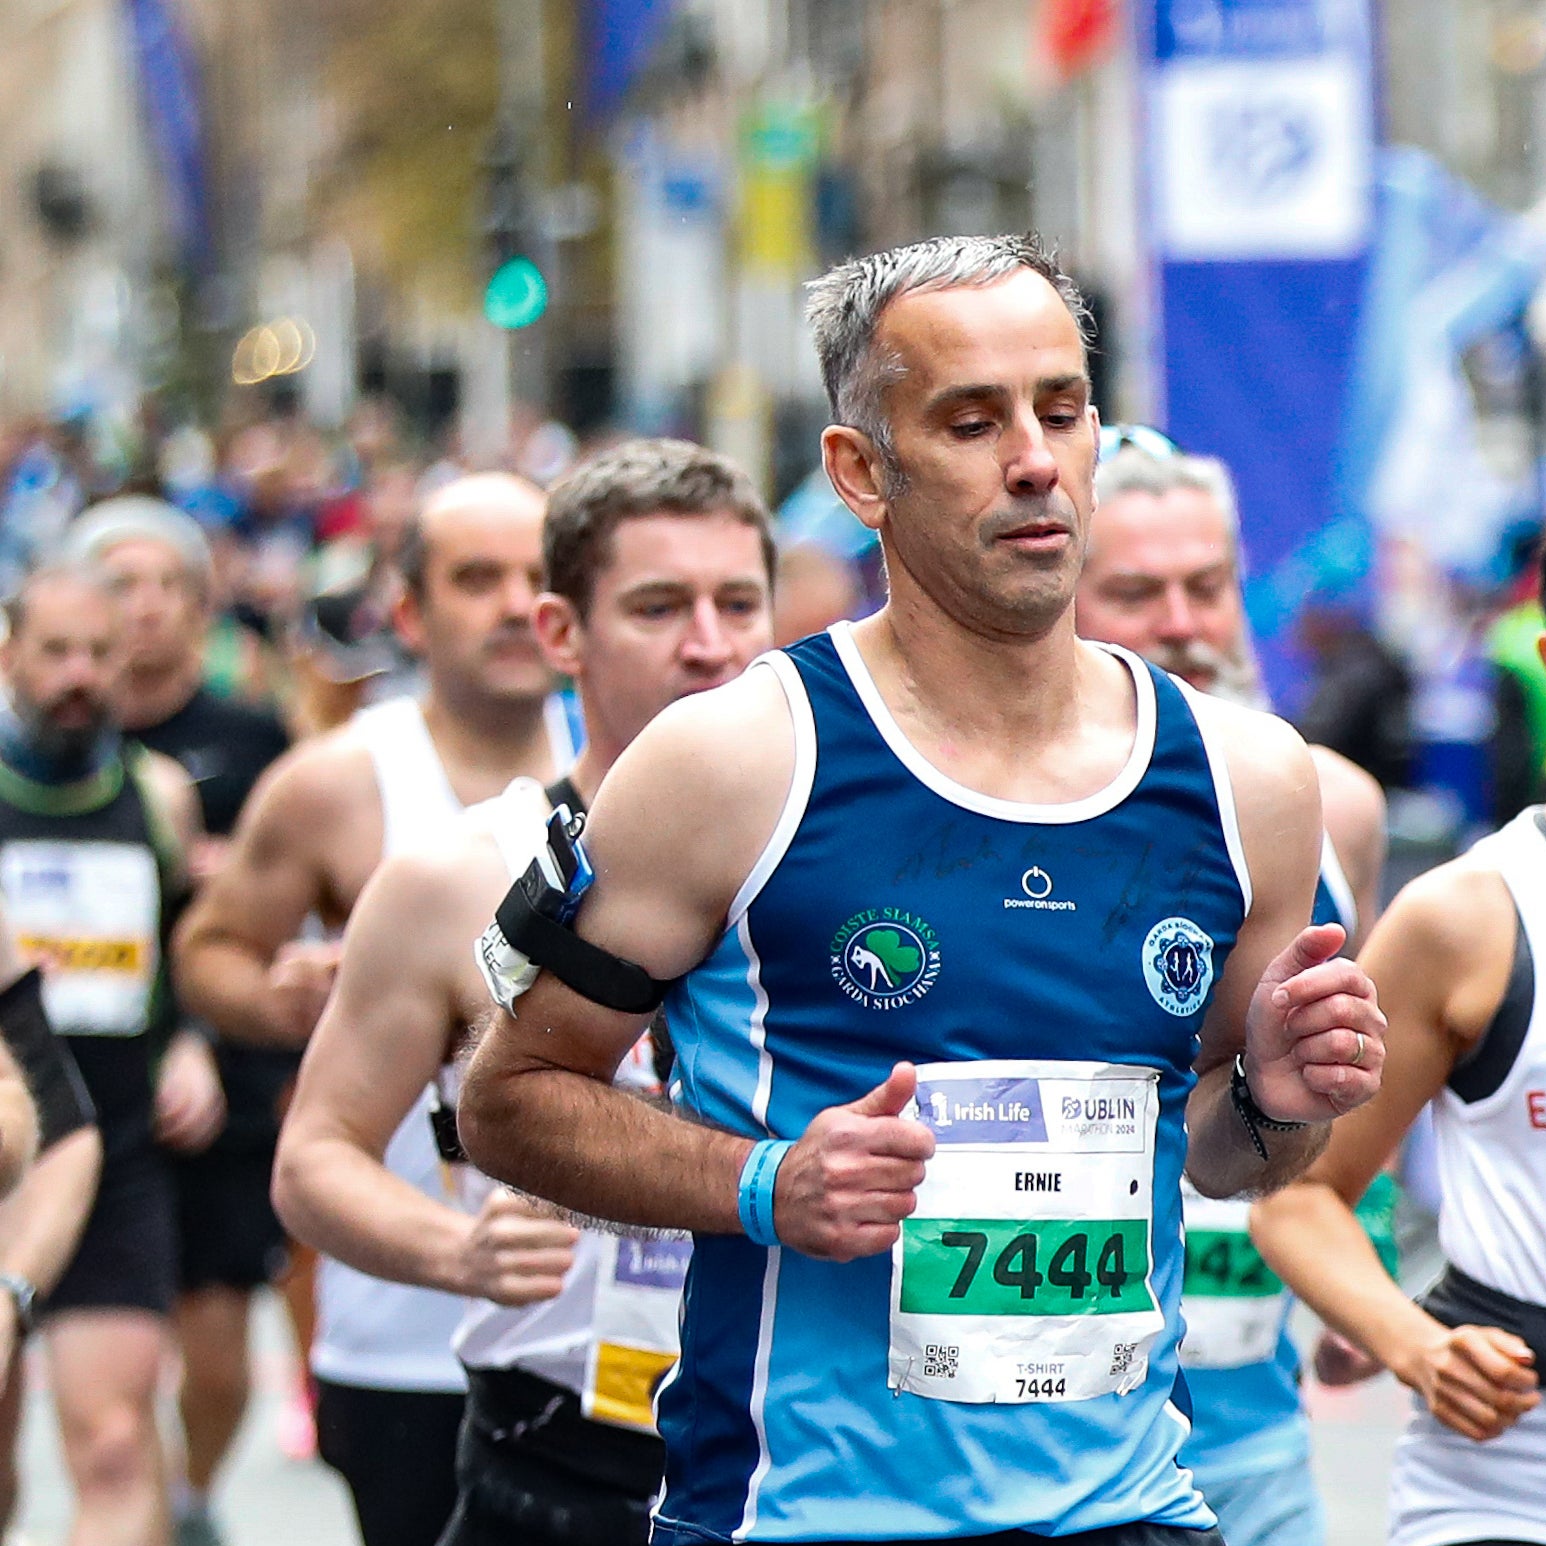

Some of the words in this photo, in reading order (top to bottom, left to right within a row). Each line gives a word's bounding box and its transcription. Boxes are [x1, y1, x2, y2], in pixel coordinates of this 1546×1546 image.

[829, 907, 880, 953] COISTE
[882, 906, 940, 951] SIAMSA
[831, 966, 869, 1008] GARDA
[954, 1102, 995, 1122] Irish
[998, 1103, 1031, 1123] Life
[1062, 1096, 1134, 1121] DUBLIN
[1116, 1124, 1135, 1135] 2024
[1014, 1171, 1062, 1192] ERNIE
[941, 1231, 1128, 1299] 7444
[1017, 1363, 1065, 1375] T-SHIRT
[1015, 1378, 1066, 1397] 7444
